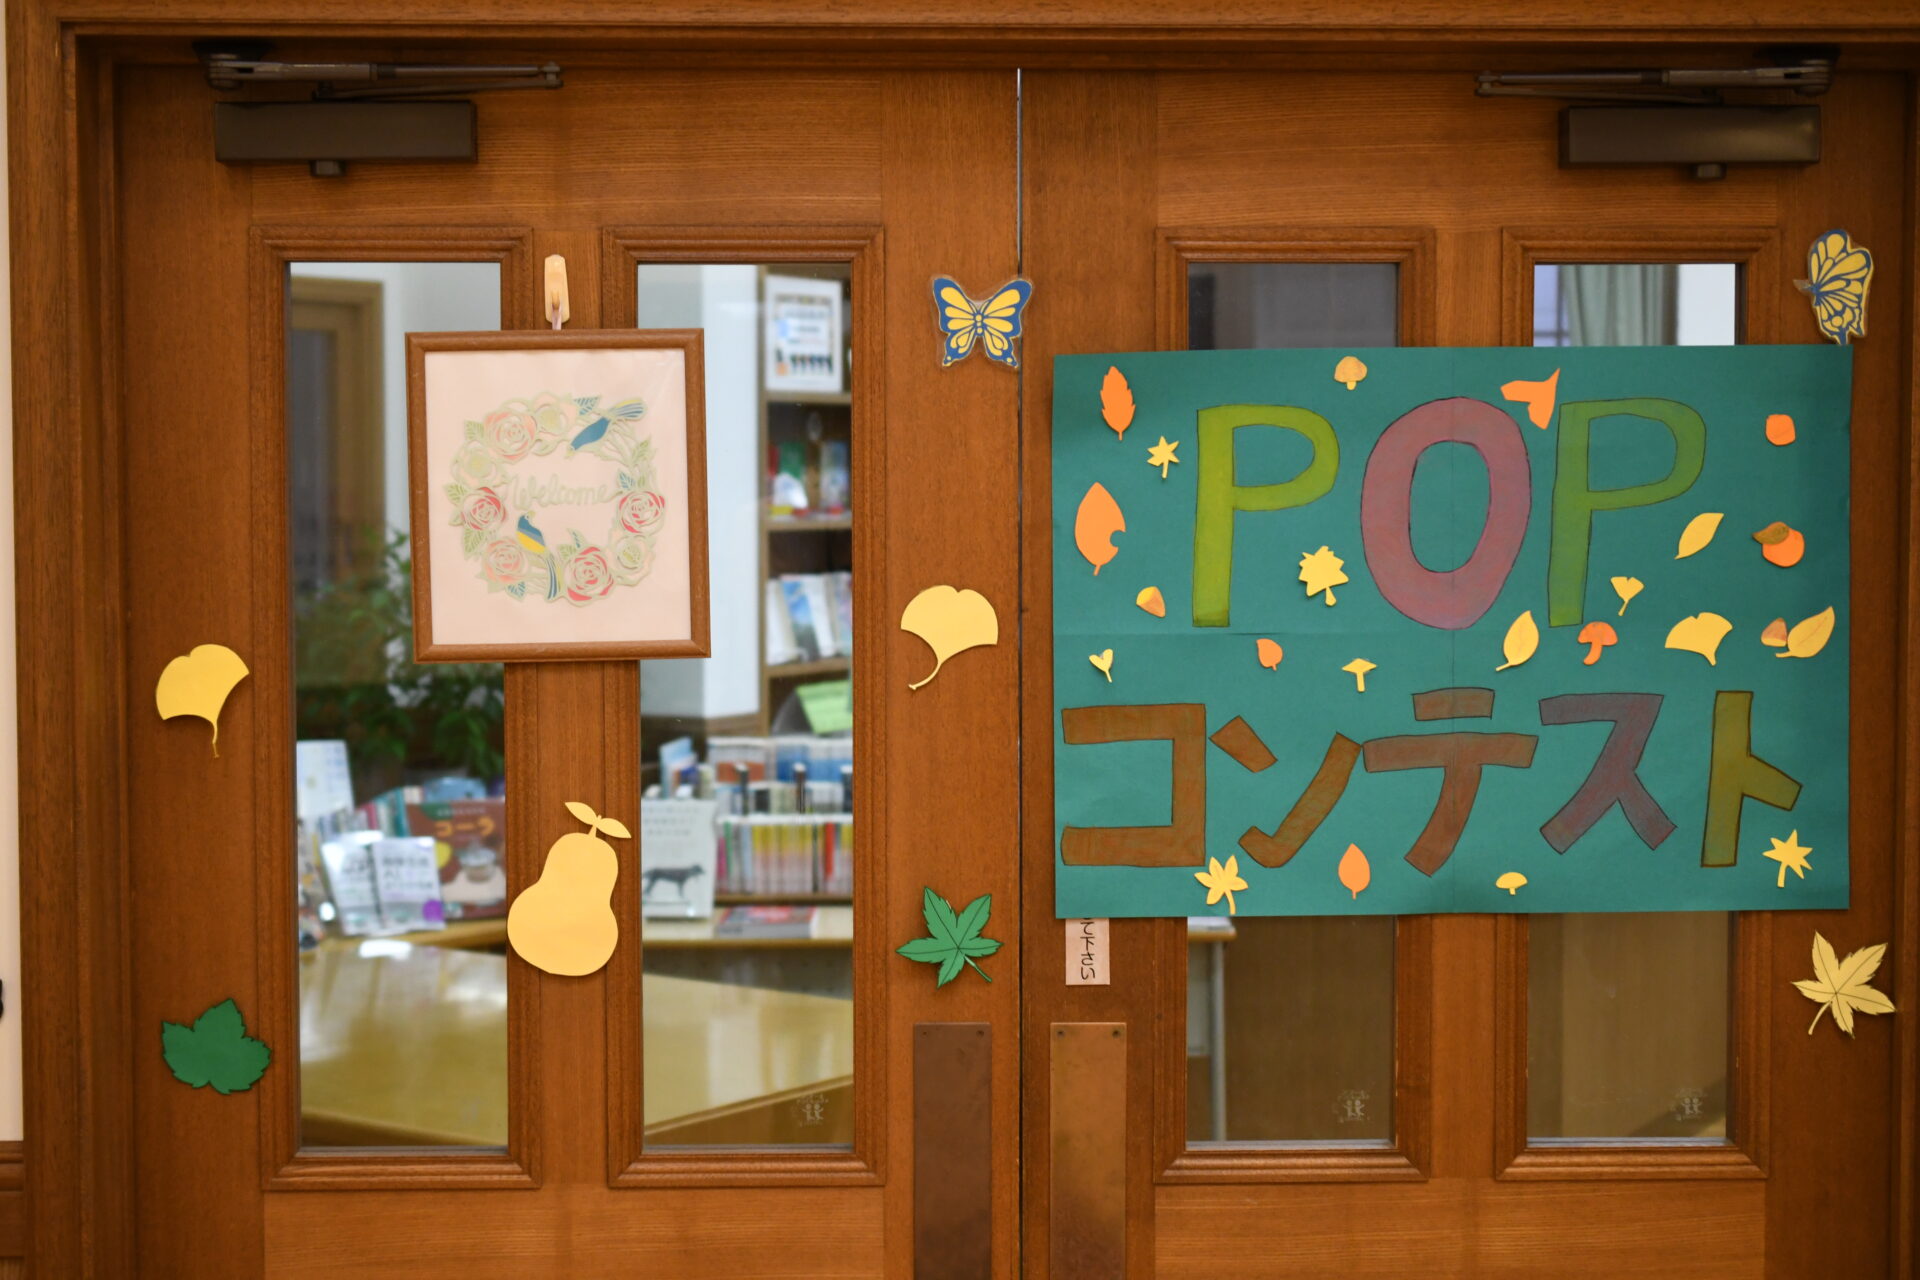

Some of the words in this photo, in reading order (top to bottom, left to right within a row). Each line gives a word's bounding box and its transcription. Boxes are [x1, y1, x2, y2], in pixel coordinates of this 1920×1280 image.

[508, 473, 611, 511] Welcome
[1191, 395, 1707, 631] POP
[1060, 686, 1803, 878] コンテスト
[1079, 917, 1096, 981] て下さい
